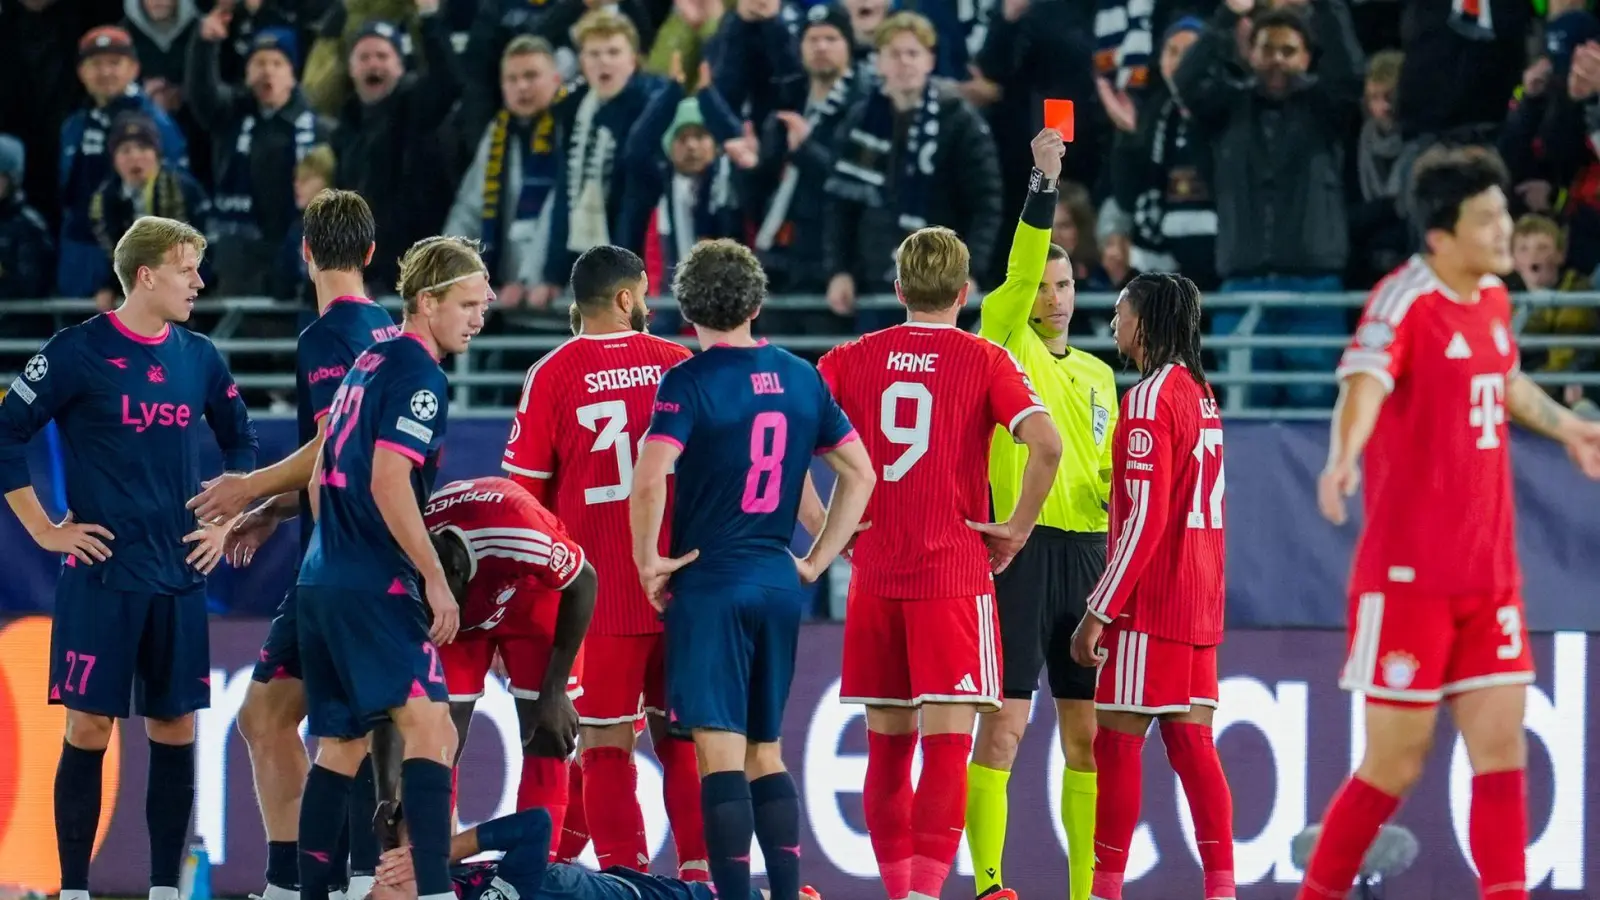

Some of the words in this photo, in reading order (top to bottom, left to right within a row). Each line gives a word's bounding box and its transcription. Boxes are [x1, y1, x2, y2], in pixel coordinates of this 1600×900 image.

[584, 365, 662, 393] SAIBARI
[750, 372, 784, 394] BELL
[886, 351, 939, 373] KANE
[122, 394, 191, 433] Lyse
[880, 381, 933, 482] 9
[741, 411, 788, 513] 8
[1186, 428, 1225, 530] 17
[423, 491, 505, 516] UPAMEC
[1496, 604, 1523, 661] 3
[65, 650, 97, 695] 27
